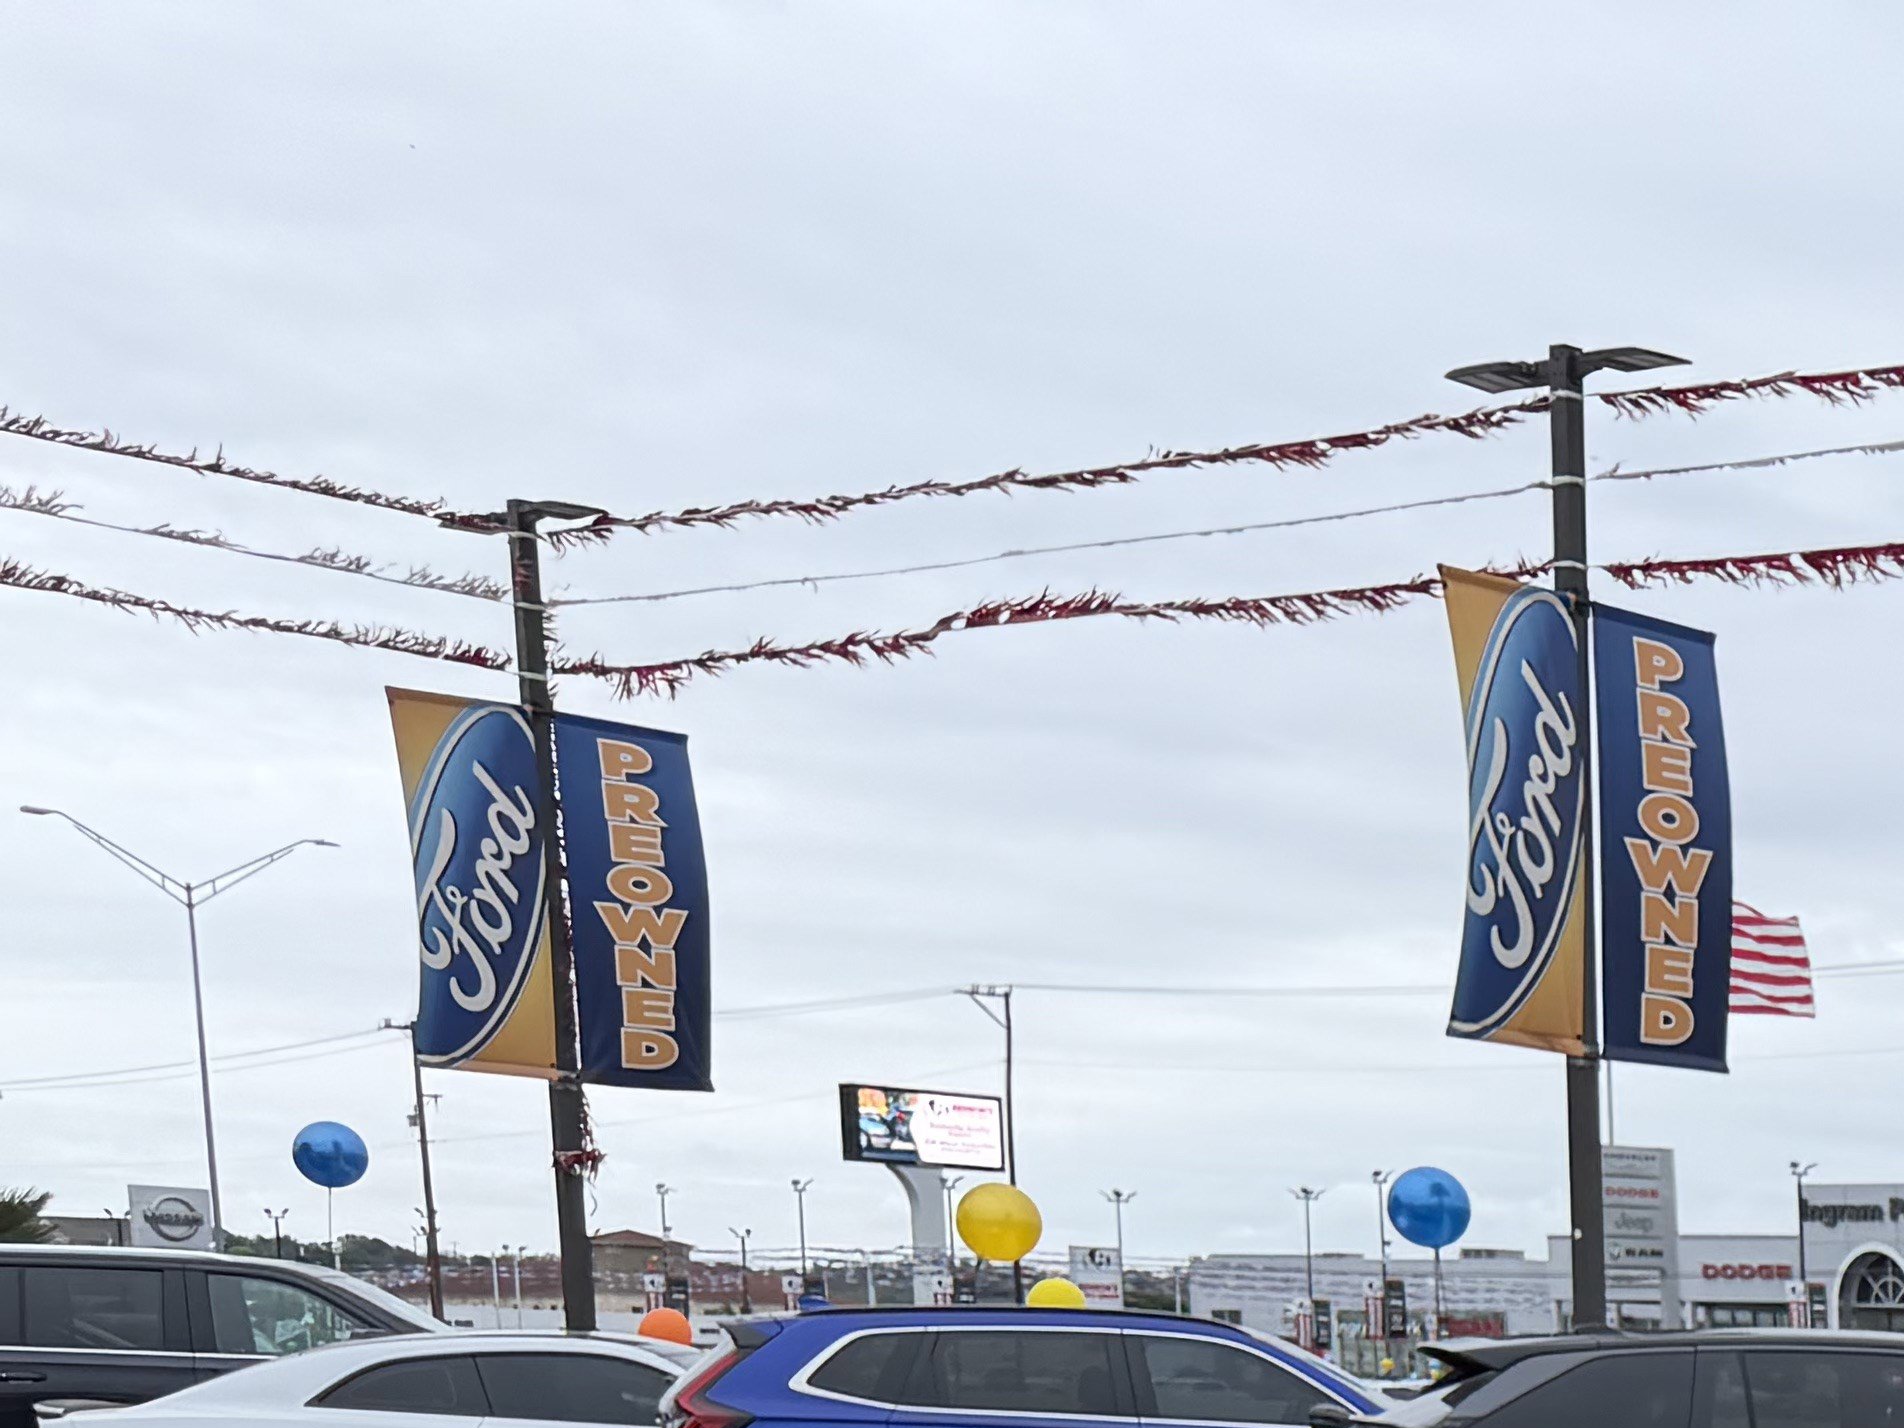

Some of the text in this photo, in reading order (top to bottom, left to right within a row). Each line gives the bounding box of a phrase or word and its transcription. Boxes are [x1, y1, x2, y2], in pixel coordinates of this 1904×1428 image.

[420, 759, 536, 1012] Ford
[592, 737, 689, 1070] PREOWNED
[1466, 657, 1577, 970] Ford
[1623, 635, 1713, 1046] PREOWNED
[1604, 1185, 1660, 1199] DODGE
[1702, 1263, 1793, 1280] DODGE
